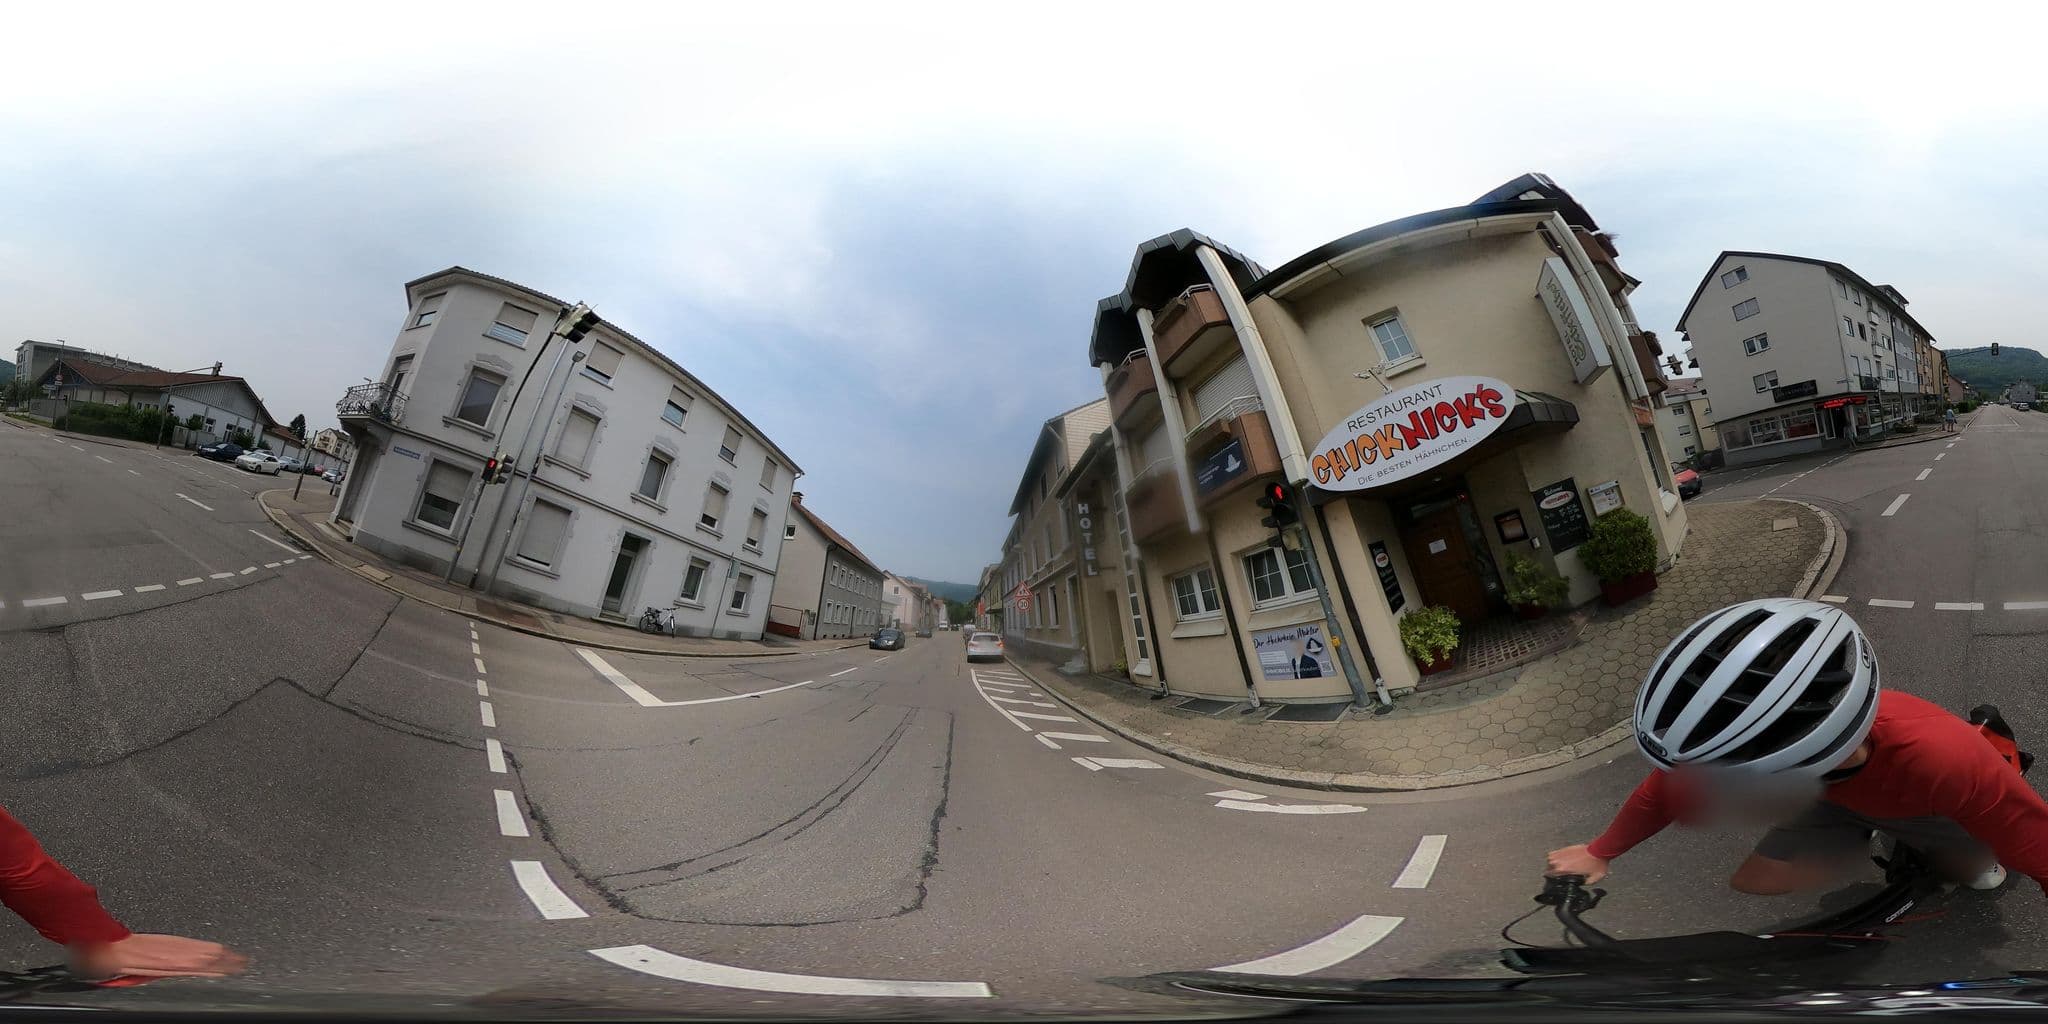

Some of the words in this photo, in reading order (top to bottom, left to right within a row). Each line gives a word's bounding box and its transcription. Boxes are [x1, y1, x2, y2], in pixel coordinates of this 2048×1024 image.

[1564, 332, 1580, 367] HOTEL
[1347, 383, 1443, 432] RESTAURANT
[1311, 383, 1507, 485] CHICKNICK'S
[1377, 459, 1412, 478] BESTEN
[1078, 503, 1098, 576] HOTEL
